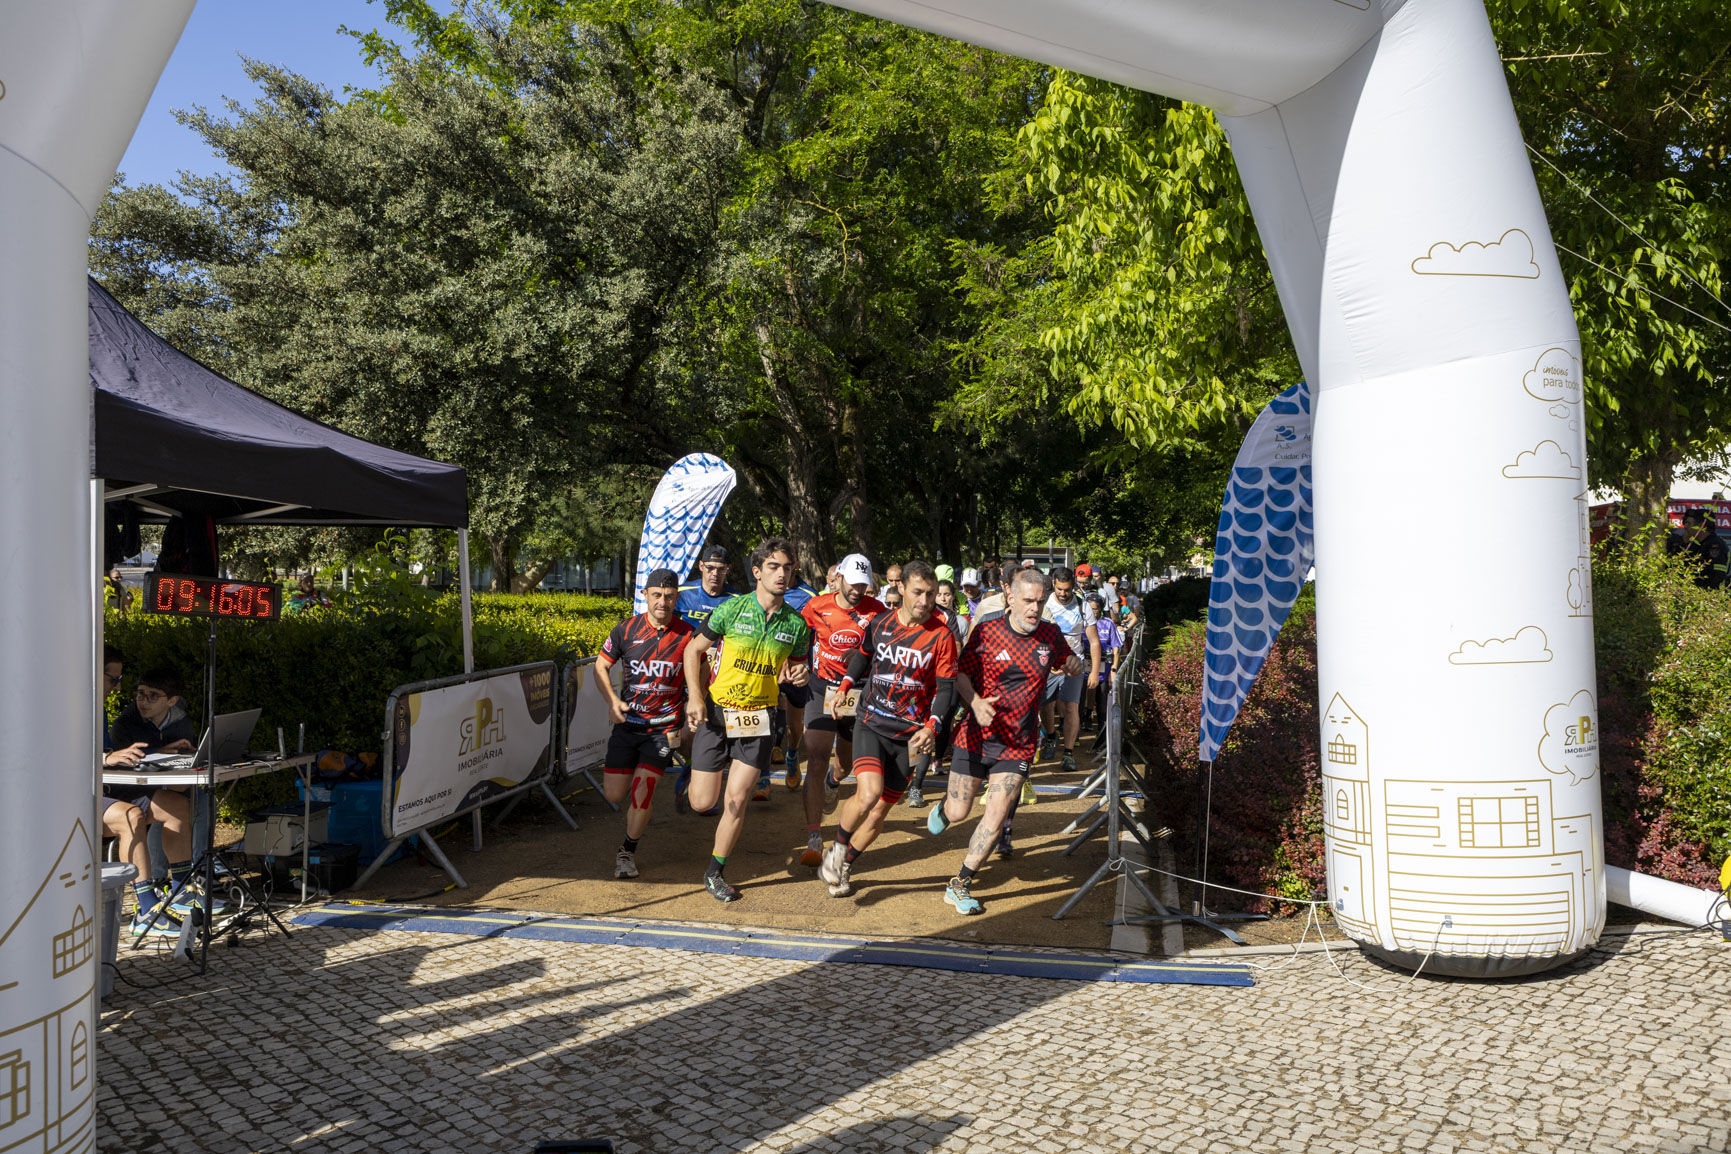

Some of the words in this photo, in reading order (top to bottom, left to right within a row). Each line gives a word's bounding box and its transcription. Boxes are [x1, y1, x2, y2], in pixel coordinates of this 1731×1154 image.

[1543, 378, 1563, 388] para
[855, 561, 868, 574] NY
[831, 634, 857, 644] Chico
[733, 658, 777, 676] CRUZADOS
[529, 671, 551, 688] +1000
[735, 715, 760, 727] 186
[457, 747, 504, 772] IMOBILIÁRIA
[398, 798, 424, 813] ESTAMOS
[424, 794, 437, 804] AQUI
[436, 790, 447, 800] POR
